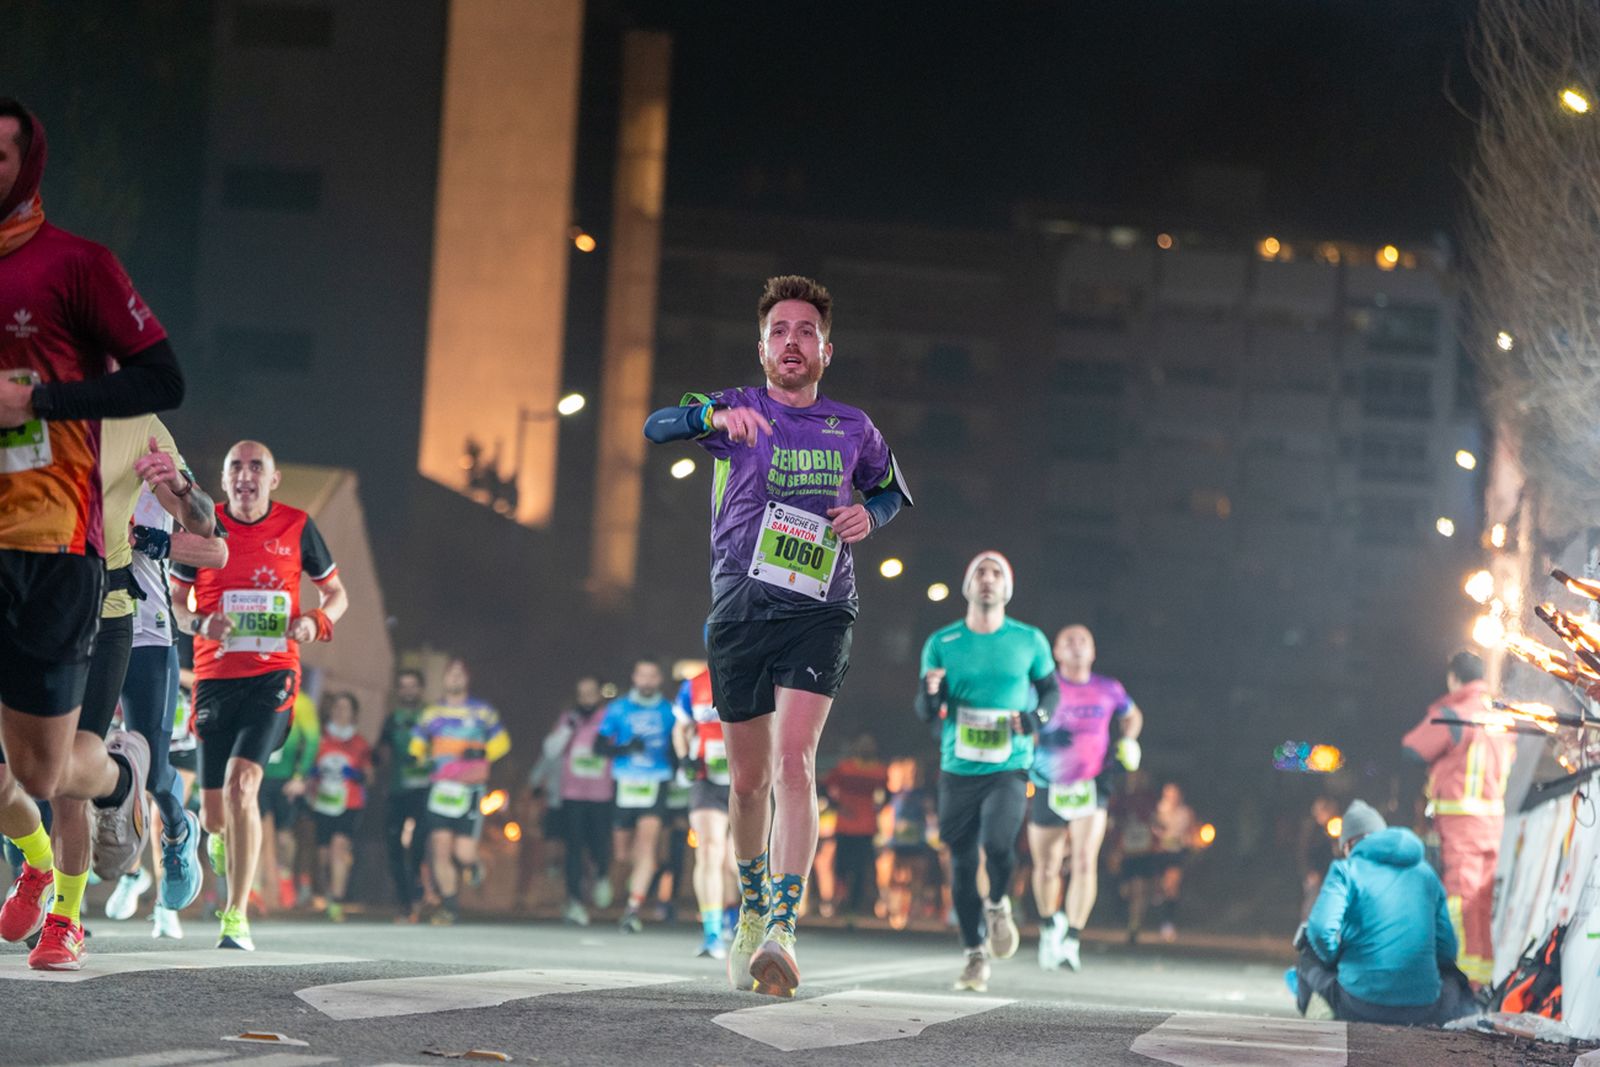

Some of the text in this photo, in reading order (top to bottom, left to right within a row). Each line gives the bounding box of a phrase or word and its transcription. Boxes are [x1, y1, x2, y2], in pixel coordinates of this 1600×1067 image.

[771, 521, 788, 533] SAN
[783, 515, 809, 529] NOCHE
[809, 524, 820, 533] DE
[774, 535, 825, 570] 1060
[237, 612, 278, 631] 7656
